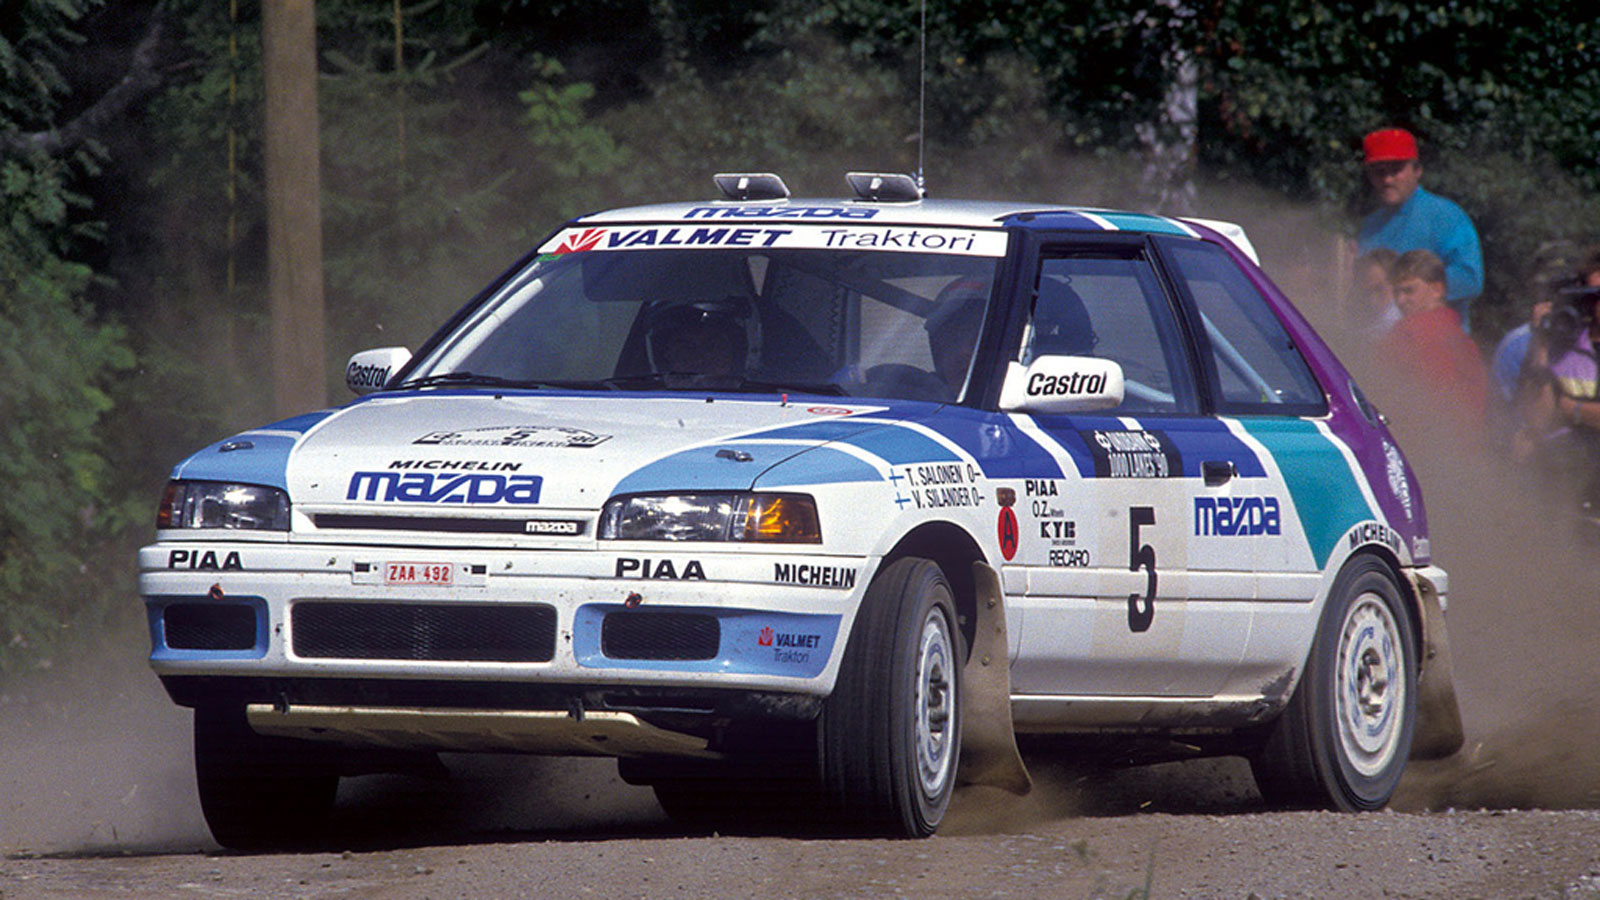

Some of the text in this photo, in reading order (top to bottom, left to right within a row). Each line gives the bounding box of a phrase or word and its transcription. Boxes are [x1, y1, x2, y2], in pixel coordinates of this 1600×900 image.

[683, 207, 880, 219] mazda
[607, 229, 976, 251] VALMET Traktori
[347, 361, 391, 388] Castrol
[1026, 371, 1108, 396] Castrol
[502, 430, 537, 443] 5
[388, 460, 523, 472] MICHELIN
[905, 467, 919, 486] T.
[918, 464, 964, 486] SALONEN
[346, 471, 544, 504] mazda
[911, 489, 926, 509] V.
[925, 487, 972, 508] SILANDER
[1025, 480, 1058, 496] PIAA
[525, 521, 578, 533] mazda
[1193, 497, 1282, 536] mazda
[1003, 510, 1016, 550] A
[1040, 521, 1076, 538] KYB
[1348, 523, 1400, 555] MICHELIN
[167, 550, 244, 570] PIAA
[614, 557, 708, 580] PIAA
[1049, 549, 1090, 567] RECARO
[774, 562, 857, 588] MICHELIN
[1127, 506, 1158, 633] 5
[776, 633, 821, 649] VALMET
